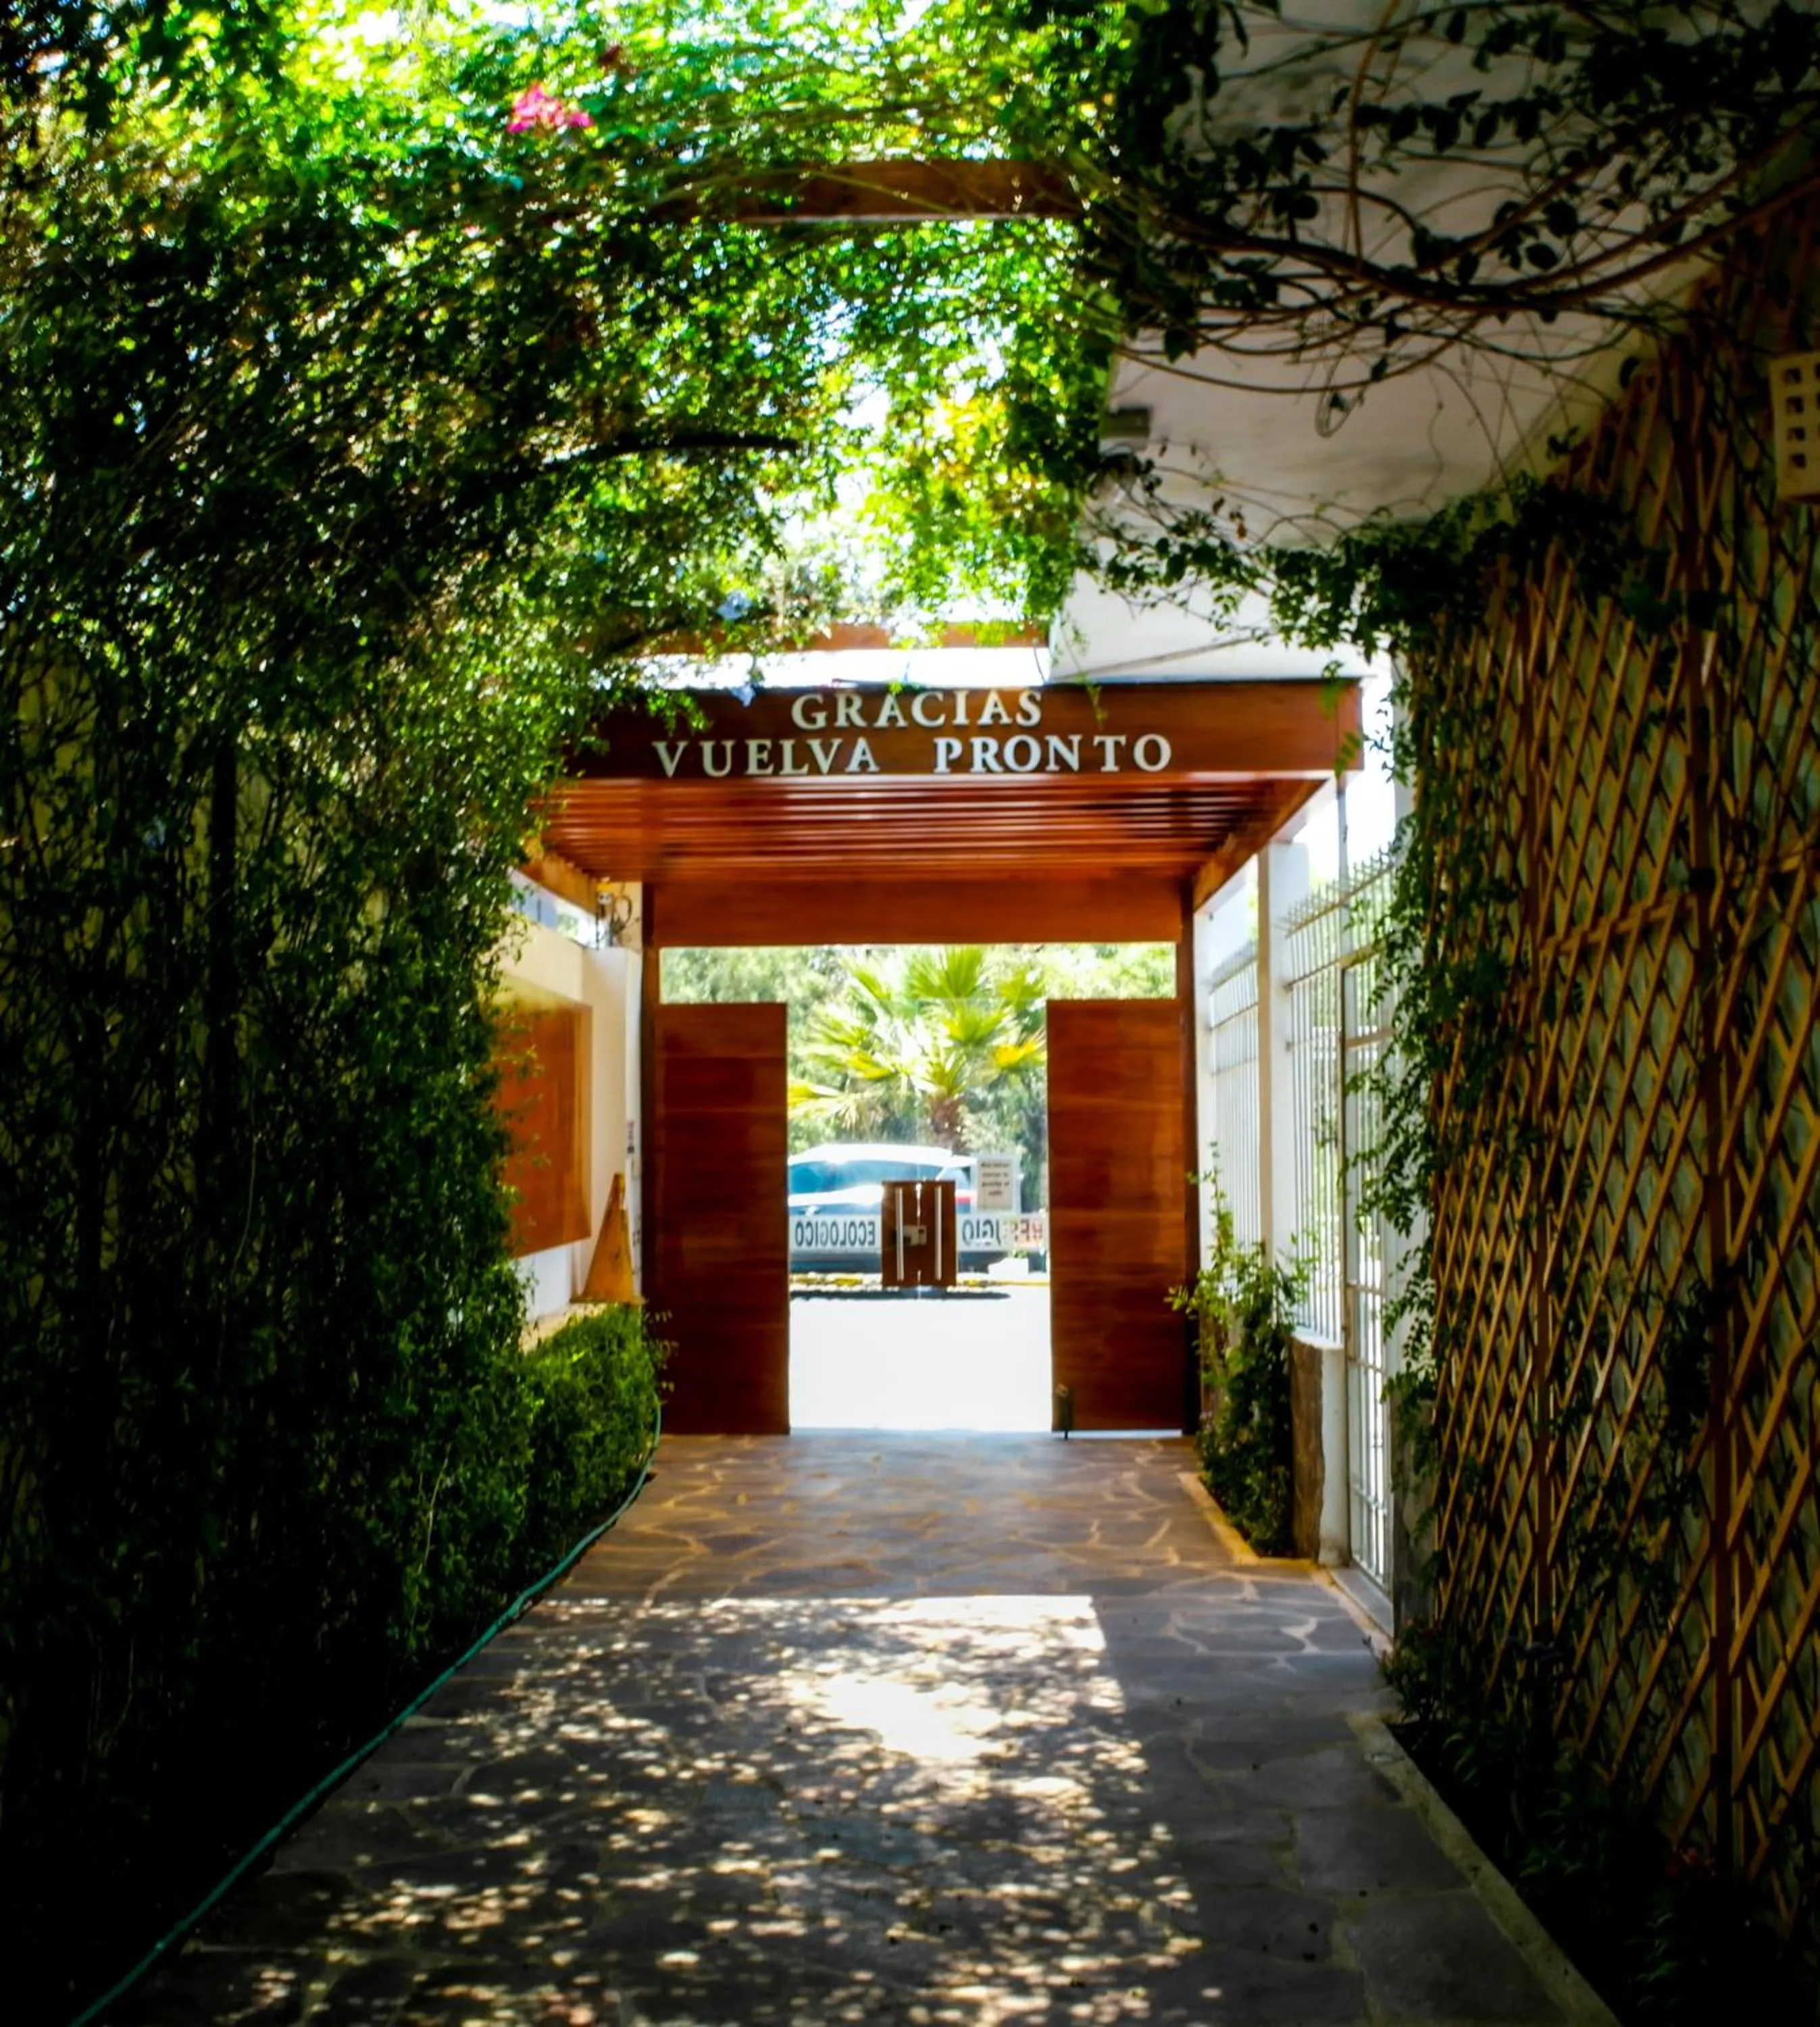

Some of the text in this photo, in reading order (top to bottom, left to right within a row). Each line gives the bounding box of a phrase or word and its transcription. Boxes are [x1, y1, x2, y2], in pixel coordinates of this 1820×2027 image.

[790, 689, 1042, 729] GRACIAS
[653, 734, 1173, 778] VUELVA PRONTO
